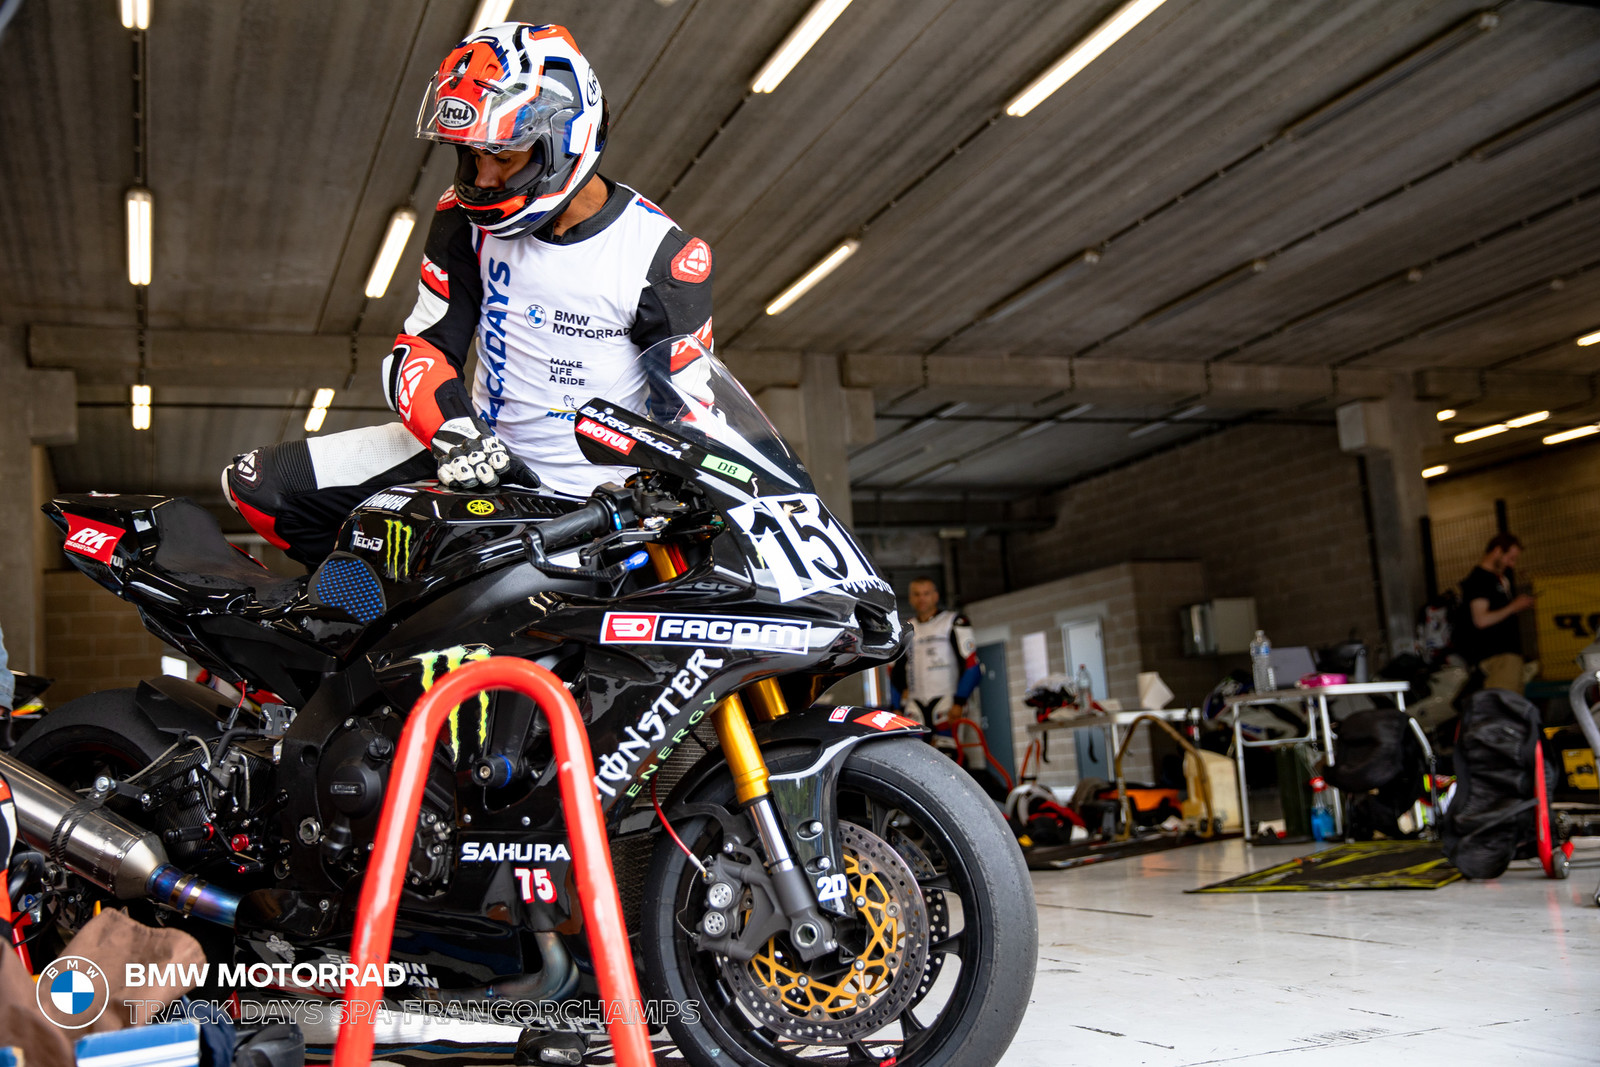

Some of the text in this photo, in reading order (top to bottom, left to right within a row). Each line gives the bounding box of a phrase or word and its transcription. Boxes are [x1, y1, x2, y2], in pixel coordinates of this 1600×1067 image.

[440, 101, 470, 121] Arai
[554, 310, 590, 326] BMW
[550, 358, 583, 369] MAKE
[550, 366, 572, 376] LIFE
[549, 375, 585, 386] A RIDE
[578, 420, 629, 451] MOTUL
[580, 406, 682, 459] BARRACUDA
[717, 462, 738, 475] DB
[70, 527, 117, 550] RK
[626, 691, 717, 798] ENERGY
[461, 842, 571, 861] SAKURA
[514, 867, 558, 904] 75
